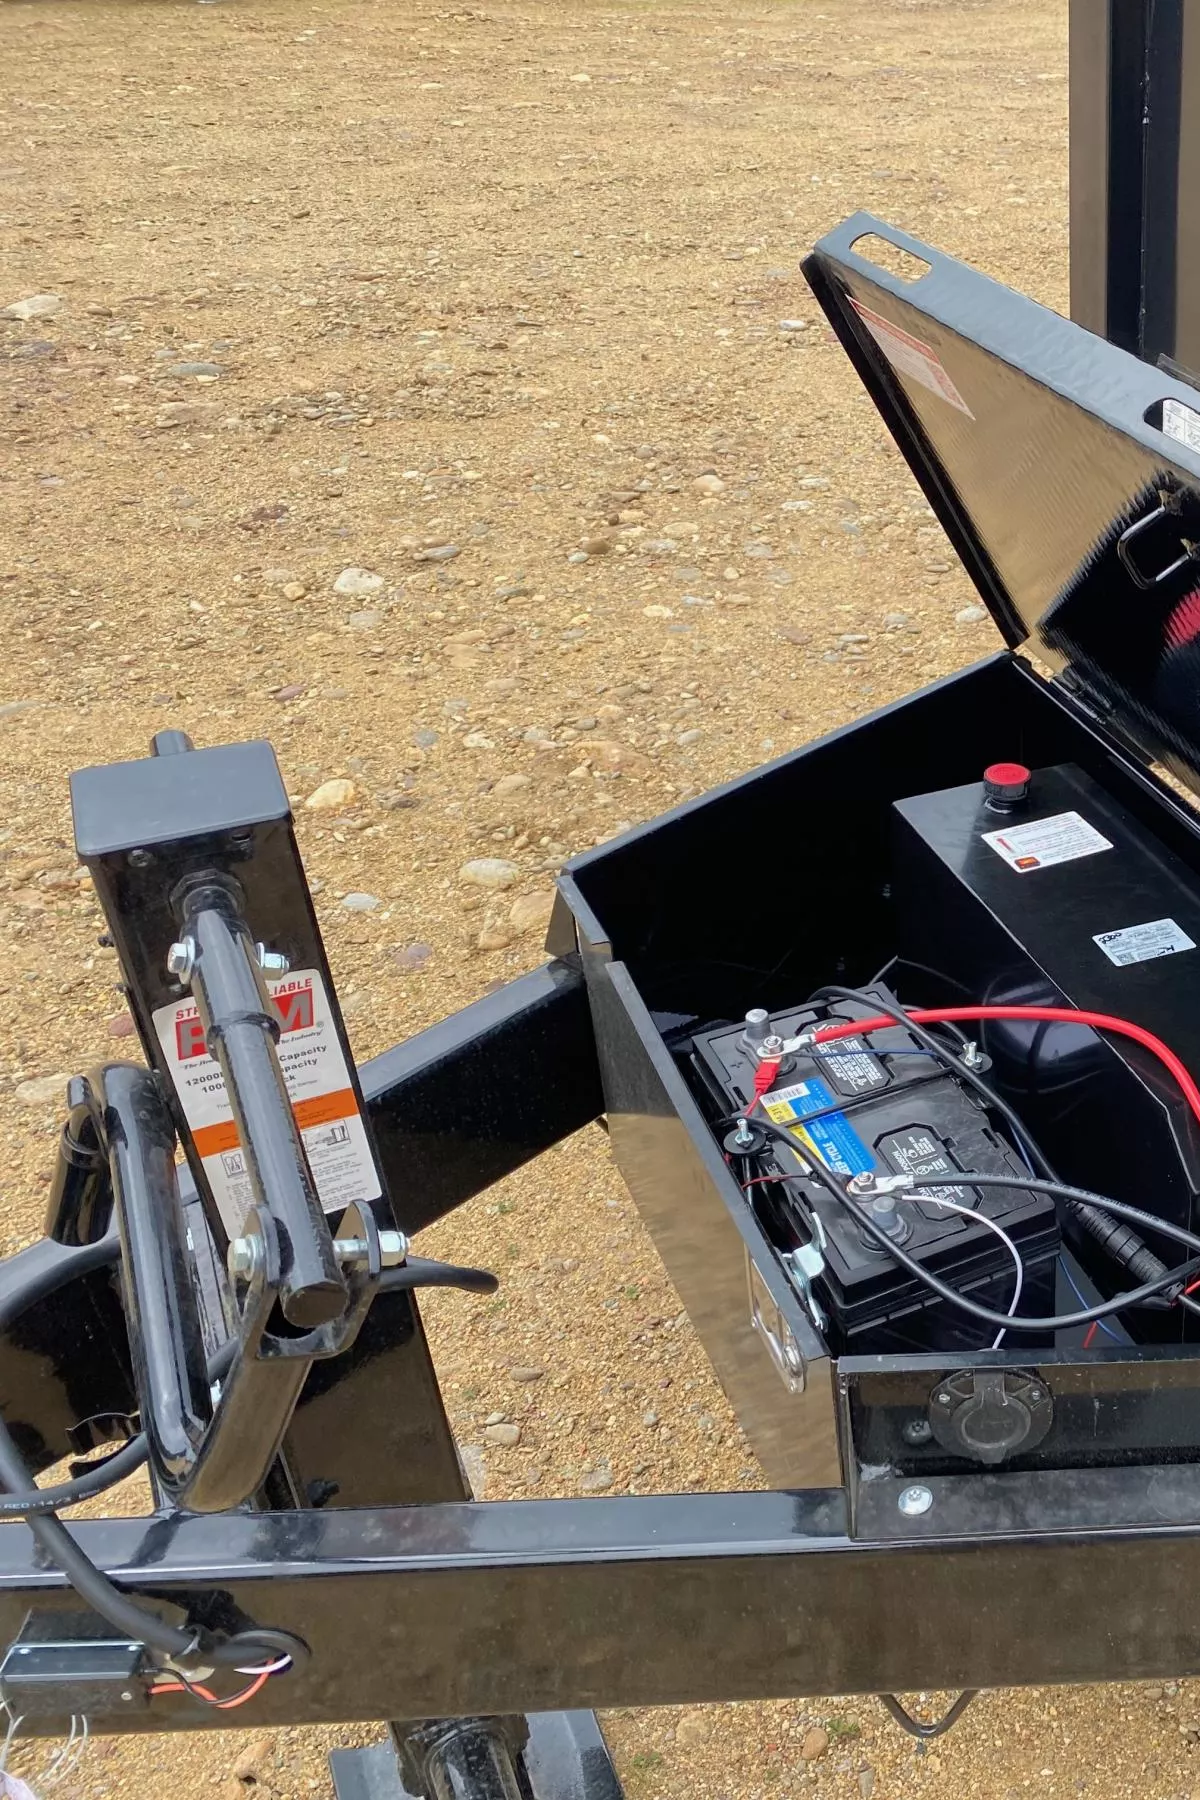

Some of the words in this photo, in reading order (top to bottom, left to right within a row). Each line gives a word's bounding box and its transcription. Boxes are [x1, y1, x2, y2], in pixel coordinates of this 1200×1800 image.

[270, 978, 313, 996] IABLE
[279, 1045, 327, 1062] Capacity
[280, 1057, 318, 1074] pacity
[822, 1140, 842, 1163] CYCLE
